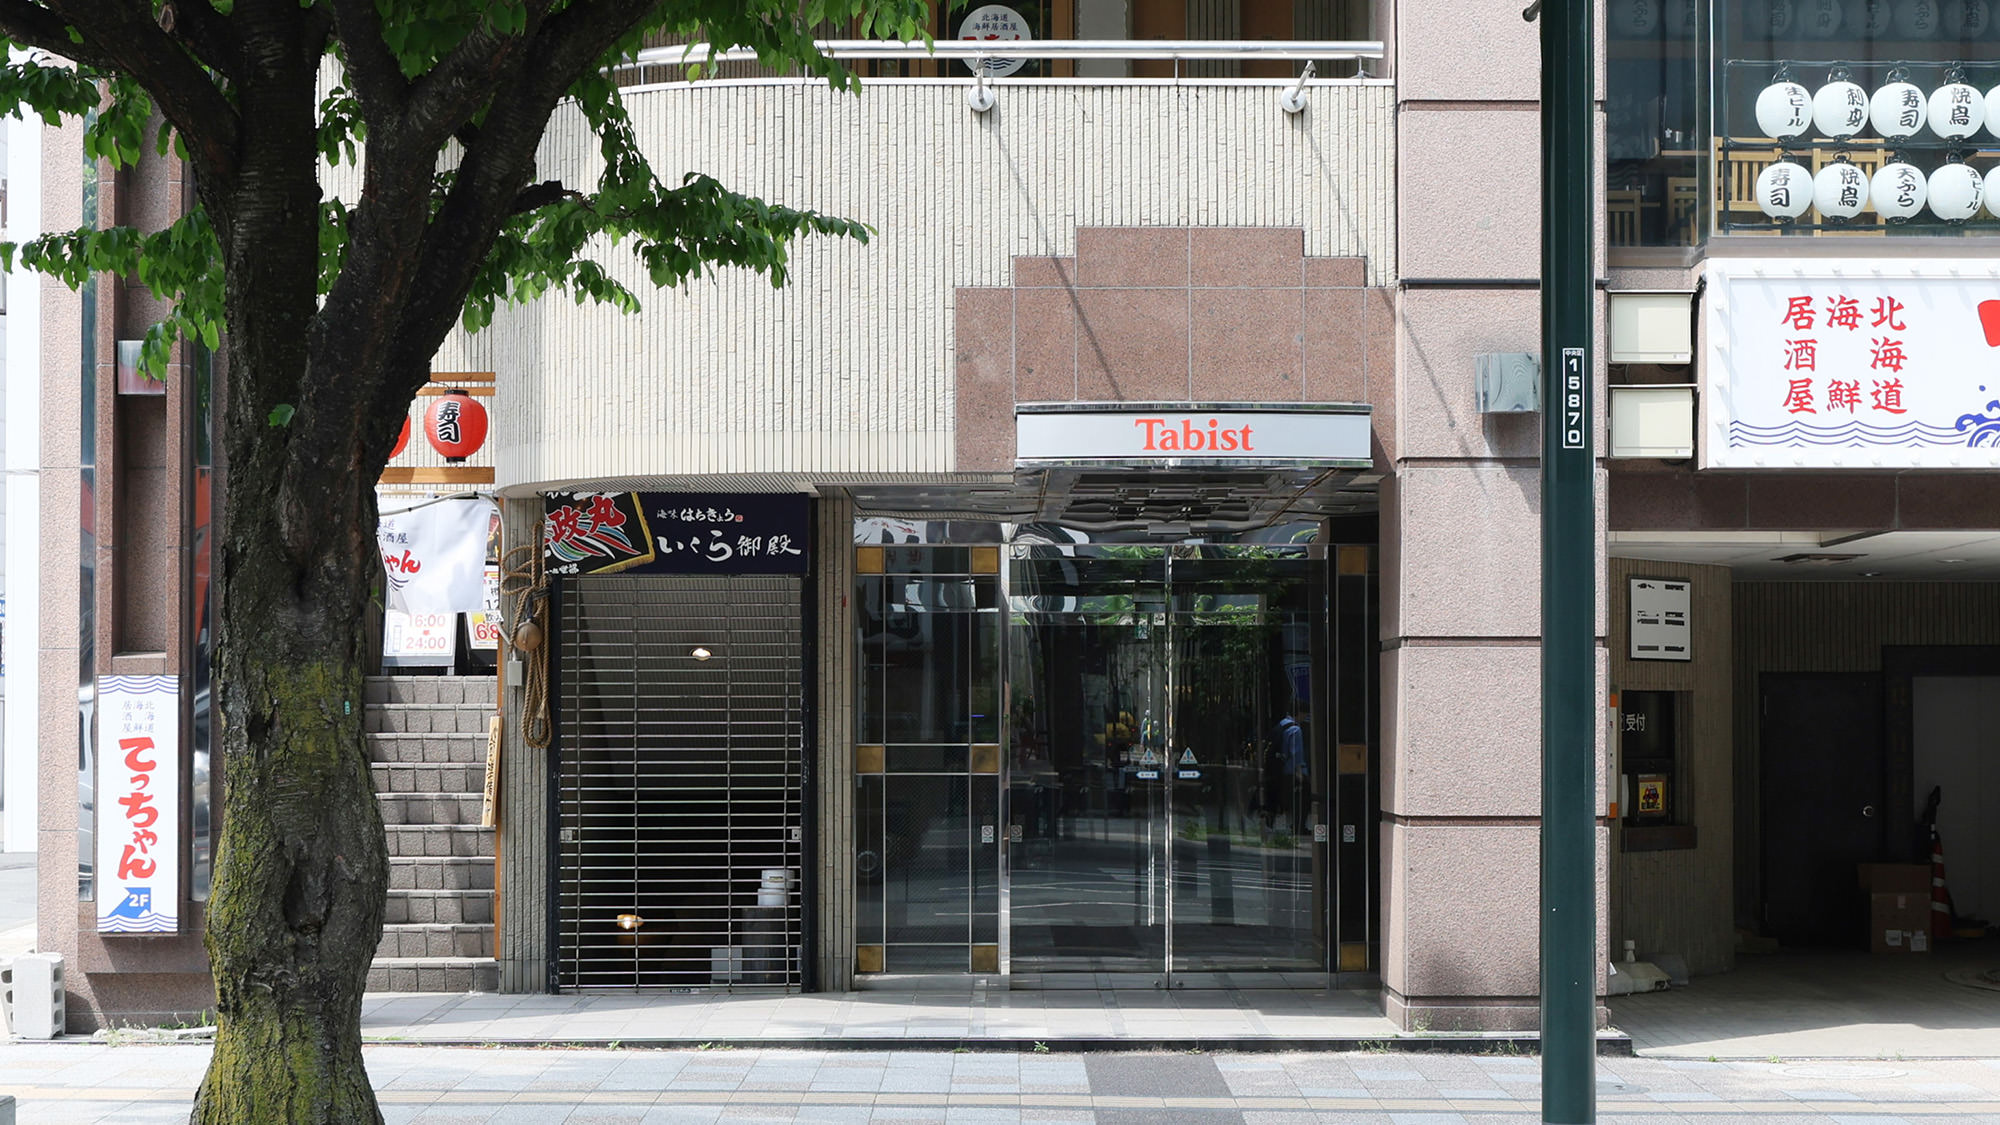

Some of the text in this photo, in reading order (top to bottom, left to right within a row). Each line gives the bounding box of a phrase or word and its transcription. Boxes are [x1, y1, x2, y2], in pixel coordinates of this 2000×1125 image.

[982, 13, 1008, 22] 北海道
[1785, 86, 1804, 127] 生ビール
[1846, 88, 1864, 127] 刺身
[1900, 89, 1919, 129] 寿司
[1949, 87, 1972, 126] 焼鳥
[1770, 168, 1791, 208] 寿司
[1838, 168, 1860, 207] 焼鳥
[1896, 167, 1916, 208] 天ぷら
[1781, 295, 1818, 415] 居酒屋
[1826, 294, 1864, 415] 海鮮
[1869, 295, 1908, 415] 北海道
[1568, 358, 1580, 443] 15870
[437, 401, 460, 442] 寿司
[1135, 418, 1254, 451] Tabist
[381, 532, 409, 545] 酒屋
[656, 529, 802, 563] いくら御殿
[382, 549, 422, 574] やん
[408, 614, 446, 627] 16:00
[406, 637, 446, 649] 24:00
[117, 737, 159, 880] てっちゃん
[128, 894, 149, 907] 2F
